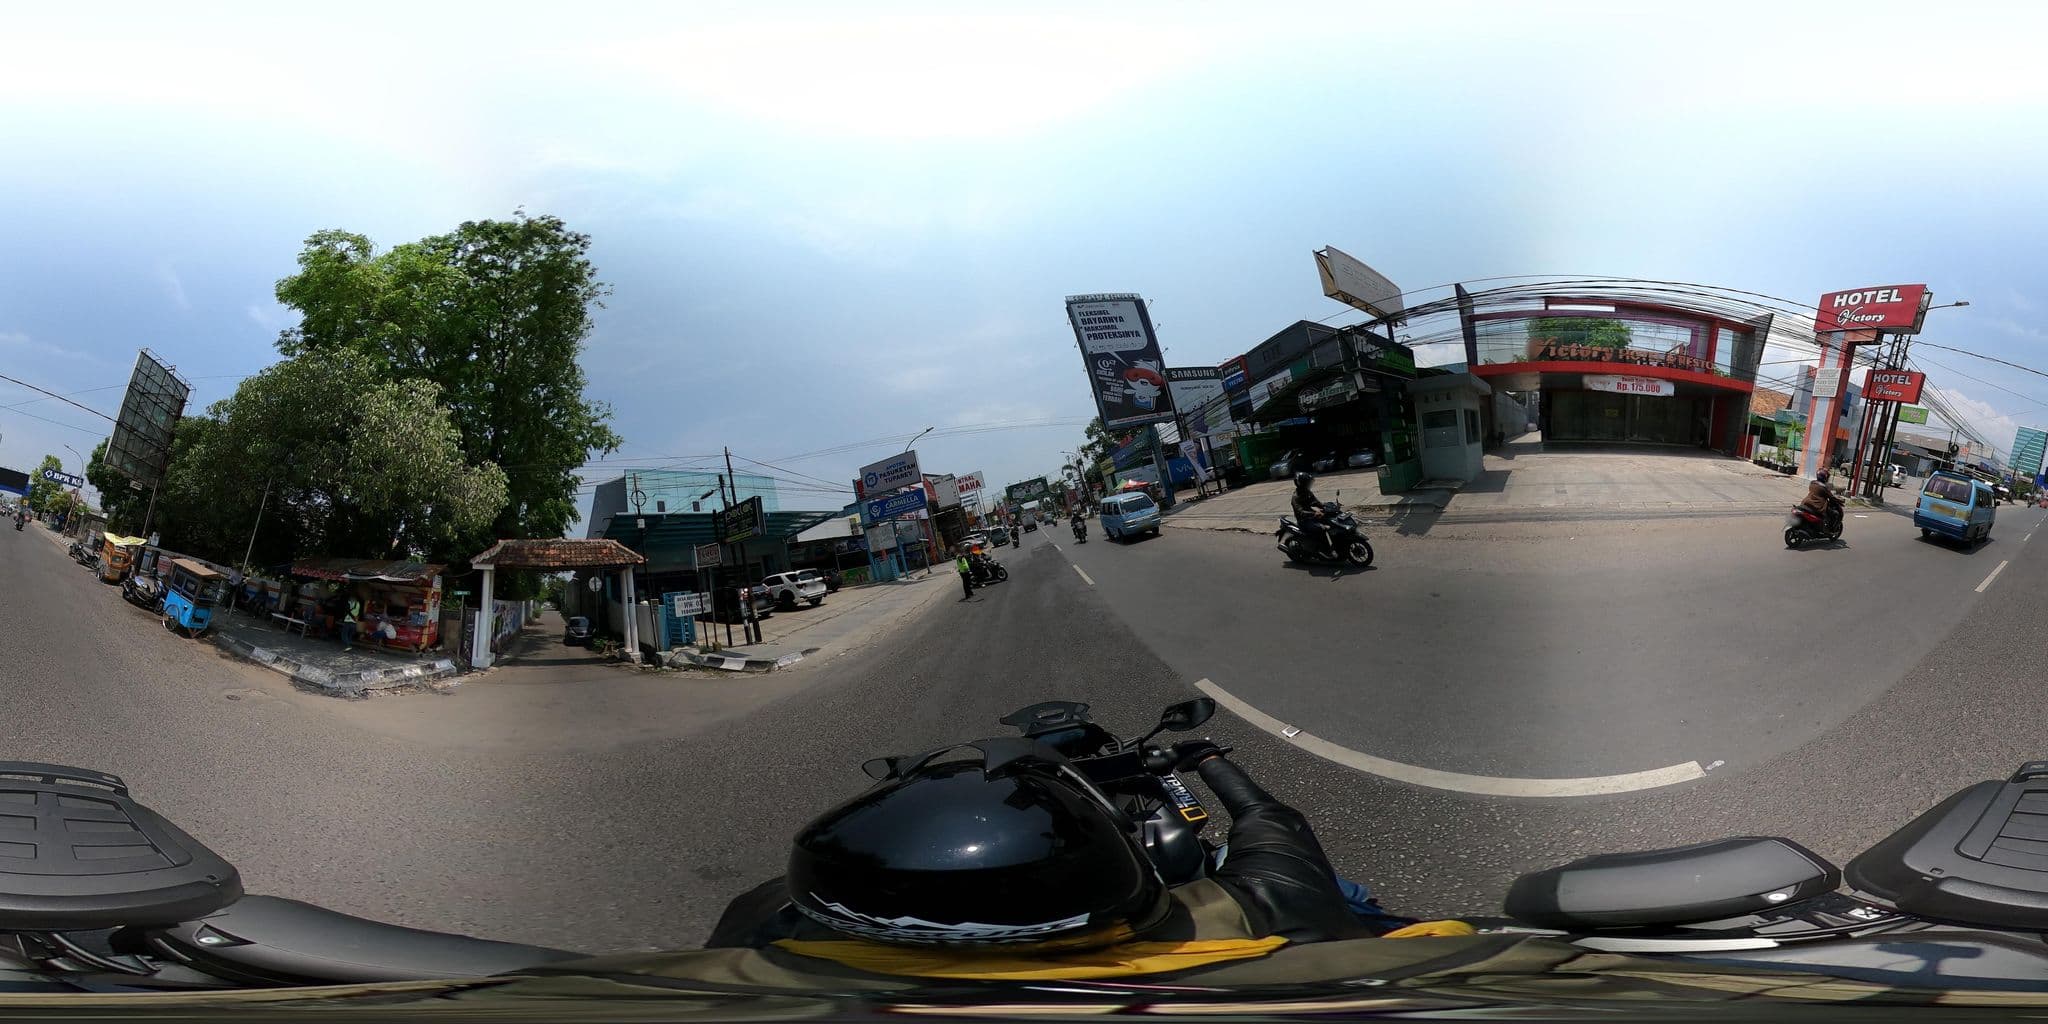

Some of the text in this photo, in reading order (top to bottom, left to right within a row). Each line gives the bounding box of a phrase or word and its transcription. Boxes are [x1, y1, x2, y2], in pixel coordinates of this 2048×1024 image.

[1833, 288, 1903, 308] HOTEL
[1080, 315, 1125, 326] BAYARNYA
[1837, 307, 1885, 326] Victory
[1086, 330, 1142, 341] PROTEKSINYA
[1171, 369, 1215, 379] SAMSUNG
[1873, 373, 1912, 385] HOTEL
[54, 472, 71, 483] BPR
[885, 494, 919, 509] CARMELLA
